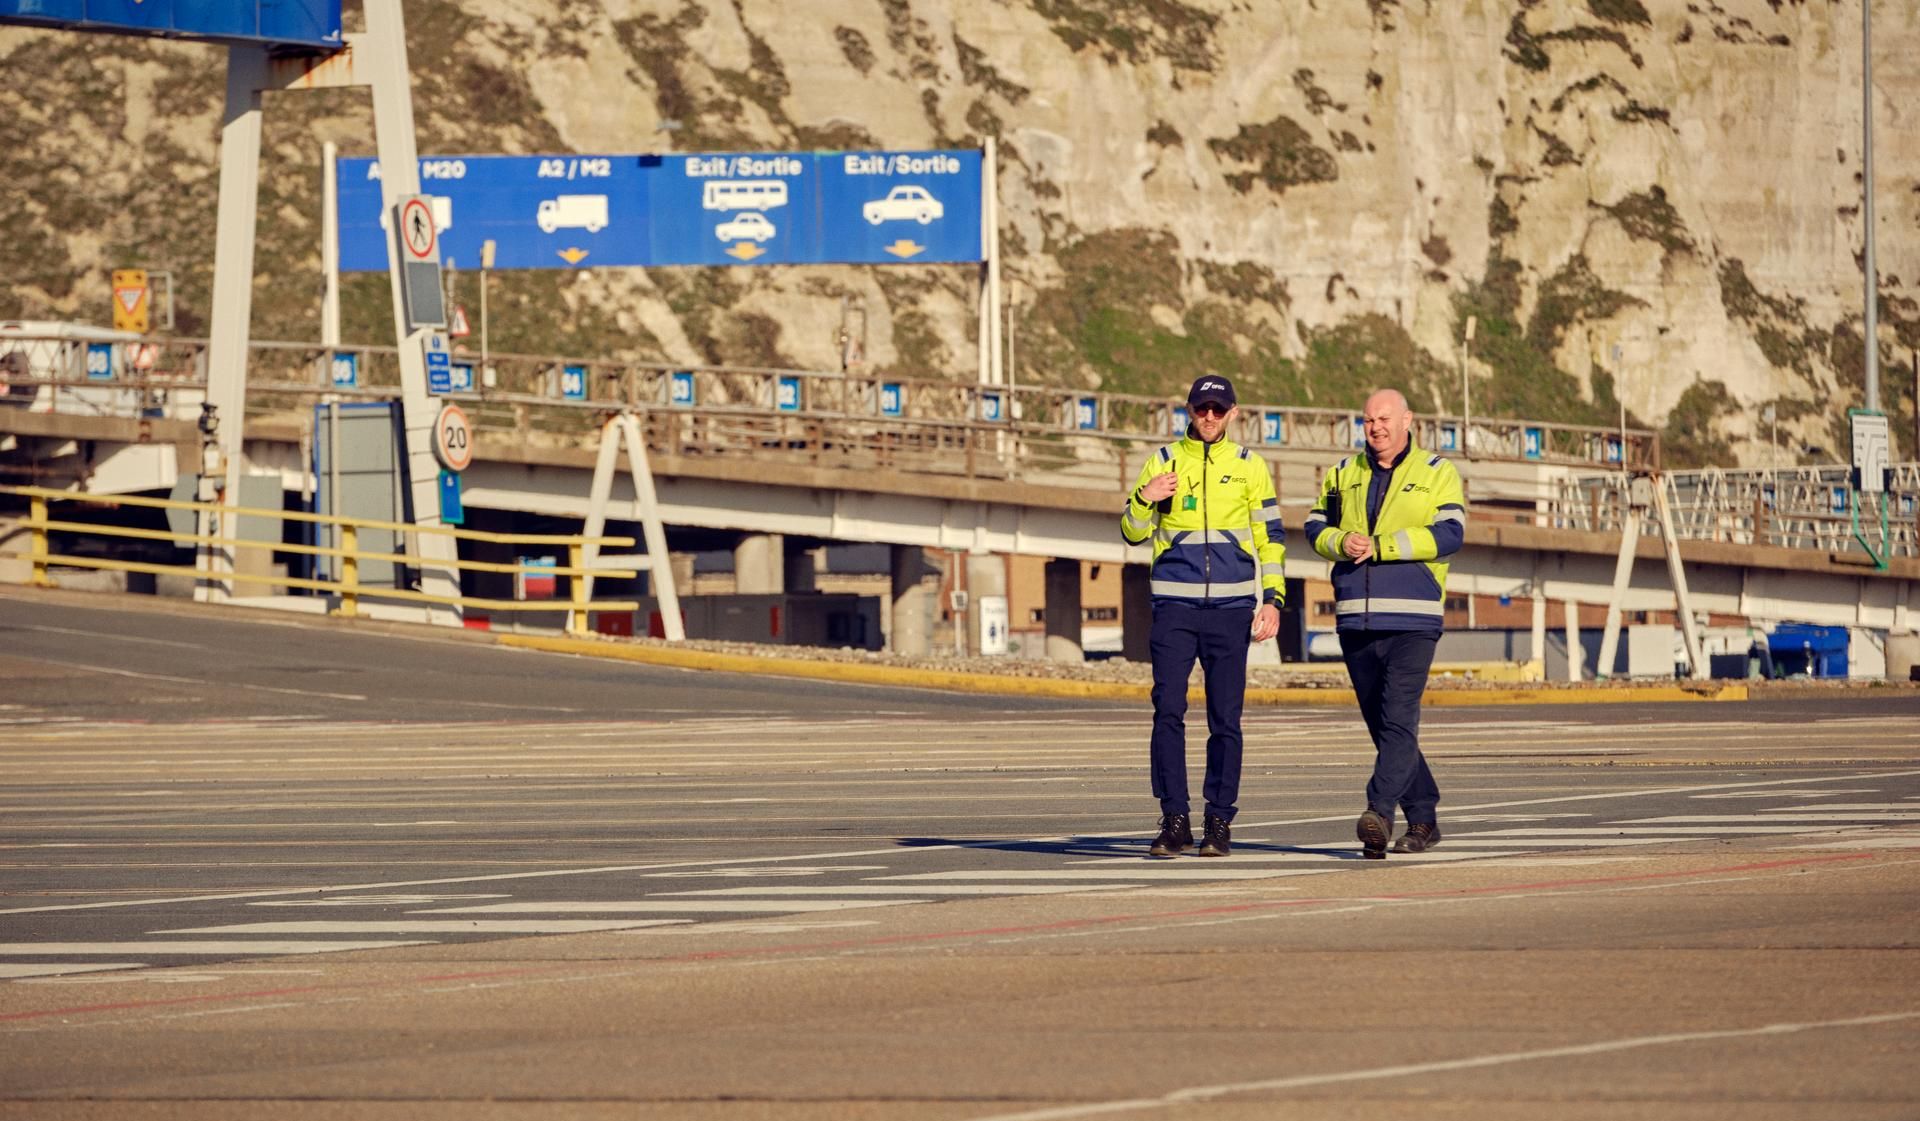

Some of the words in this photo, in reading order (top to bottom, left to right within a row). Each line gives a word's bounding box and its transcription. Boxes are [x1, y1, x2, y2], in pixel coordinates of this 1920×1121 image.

[423, 160, 467, 179] M20
[538, 160, 565, 178] A2
[568, 160, 578, 180] /
[581, 159, 612, 177] M2
[685, 157, 802, 177] Exit/Sortie
[844, 155, 960, 175] Exit/Sortie
[445, 426, 467, 448] 20
